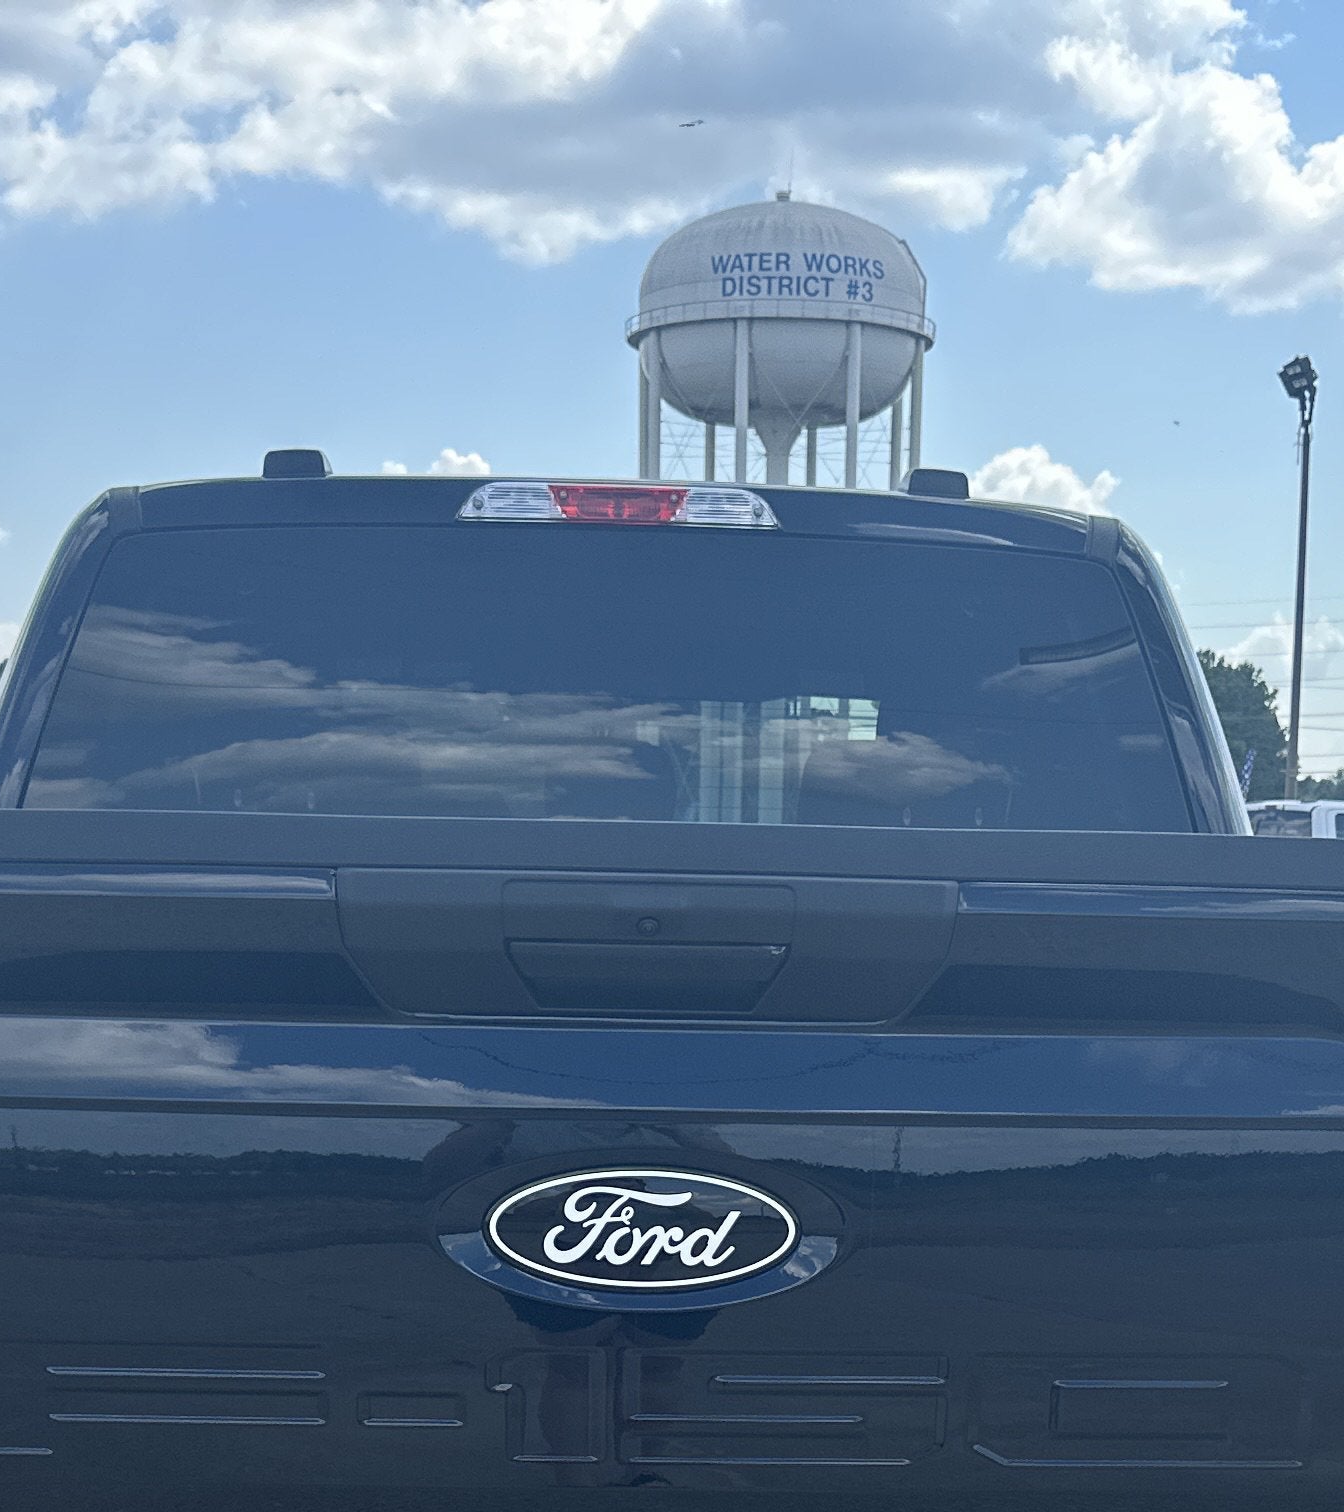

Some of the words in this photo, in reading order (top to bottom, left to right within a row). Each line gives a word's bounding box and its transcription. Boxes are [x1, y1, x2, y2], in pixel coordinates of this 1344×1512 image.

[711, 252, 791, 274] WATER
[803, 252, 885, 280] WORKS
[722, 276, 834, 298] DISTRICT
[846, 281, 874, 302] #3
[543, 1185, 741, 1267] Ford
